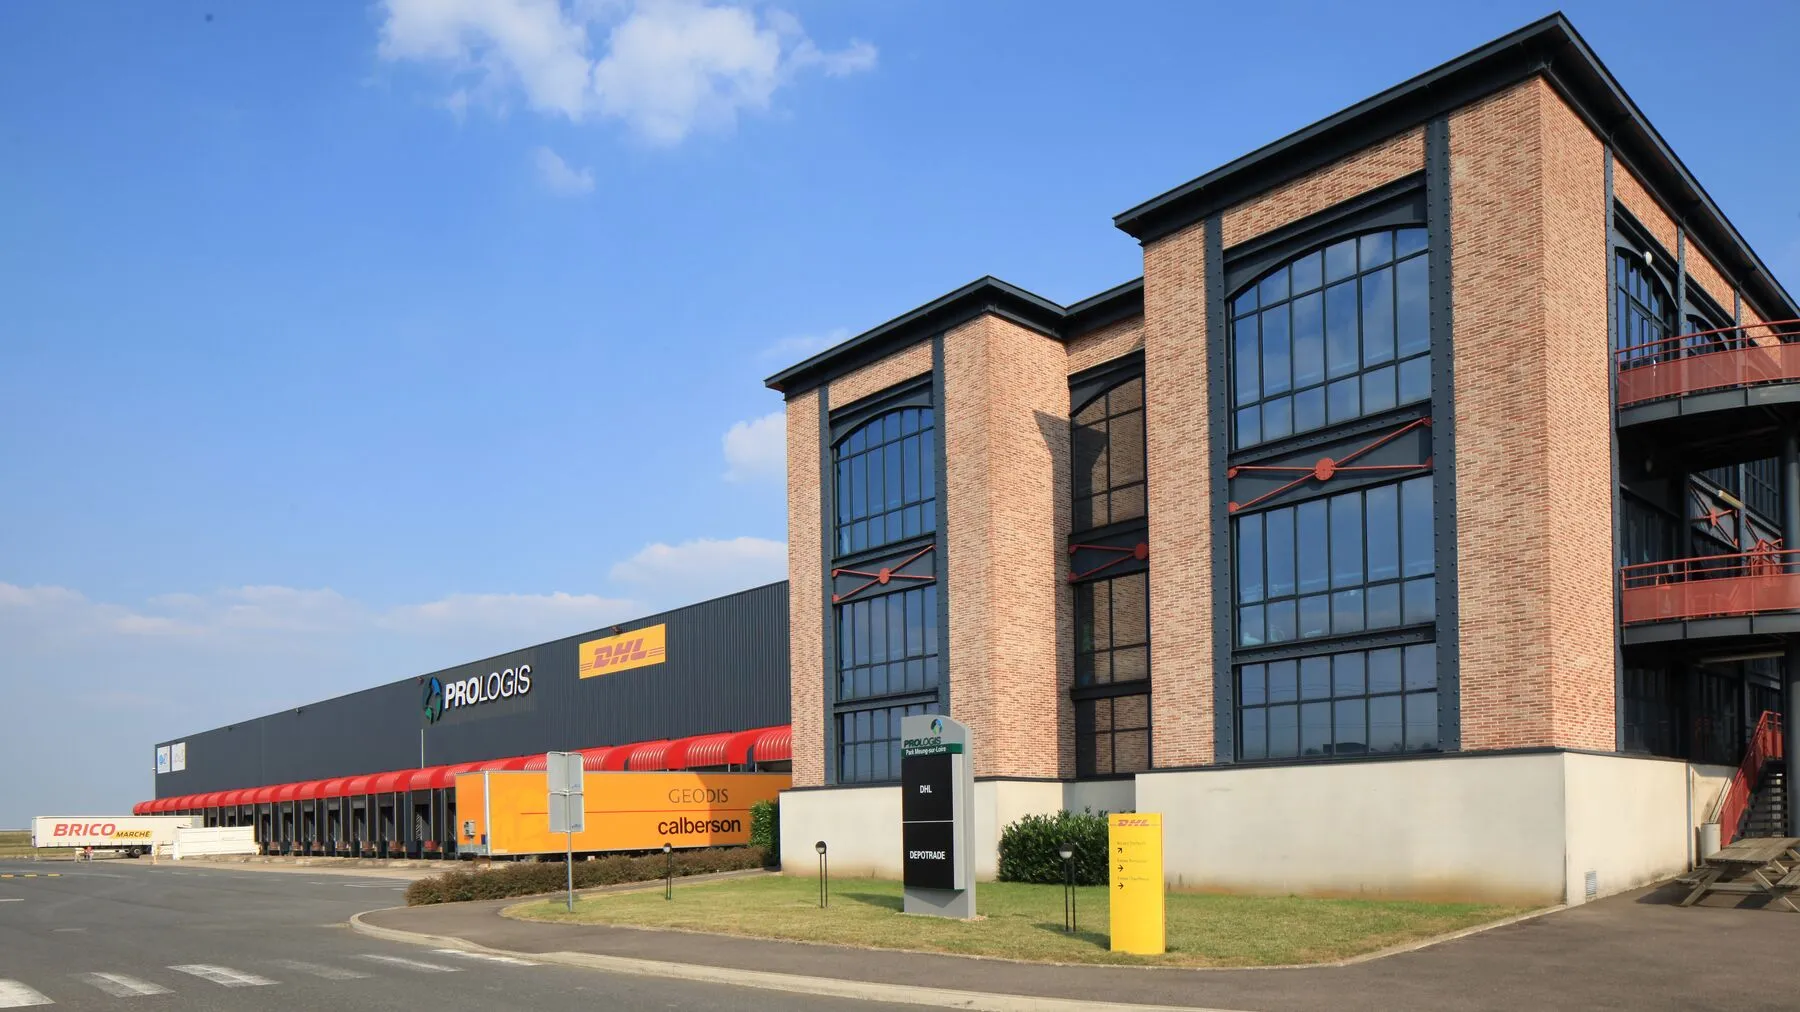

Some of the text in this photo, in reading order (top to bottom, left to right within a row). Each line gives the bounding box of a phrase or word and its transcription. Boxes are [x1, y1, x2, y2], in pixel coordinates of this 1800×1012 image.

[593, 638, 647, 668] DHL
[444, 664, 532, 709] PROLOGIS
[904, 737, 941, 748] PROLOGIS
[920, 785, 932, 793] DHL
[668, 788, 729, 804] GEODIS
[53, 823, 116, 836] BRICO
[657, 816, 742, 835] calberson
[1118, 819, 1150, 827] DHL
[909, 850, 946, 860] DEPOTRADE
